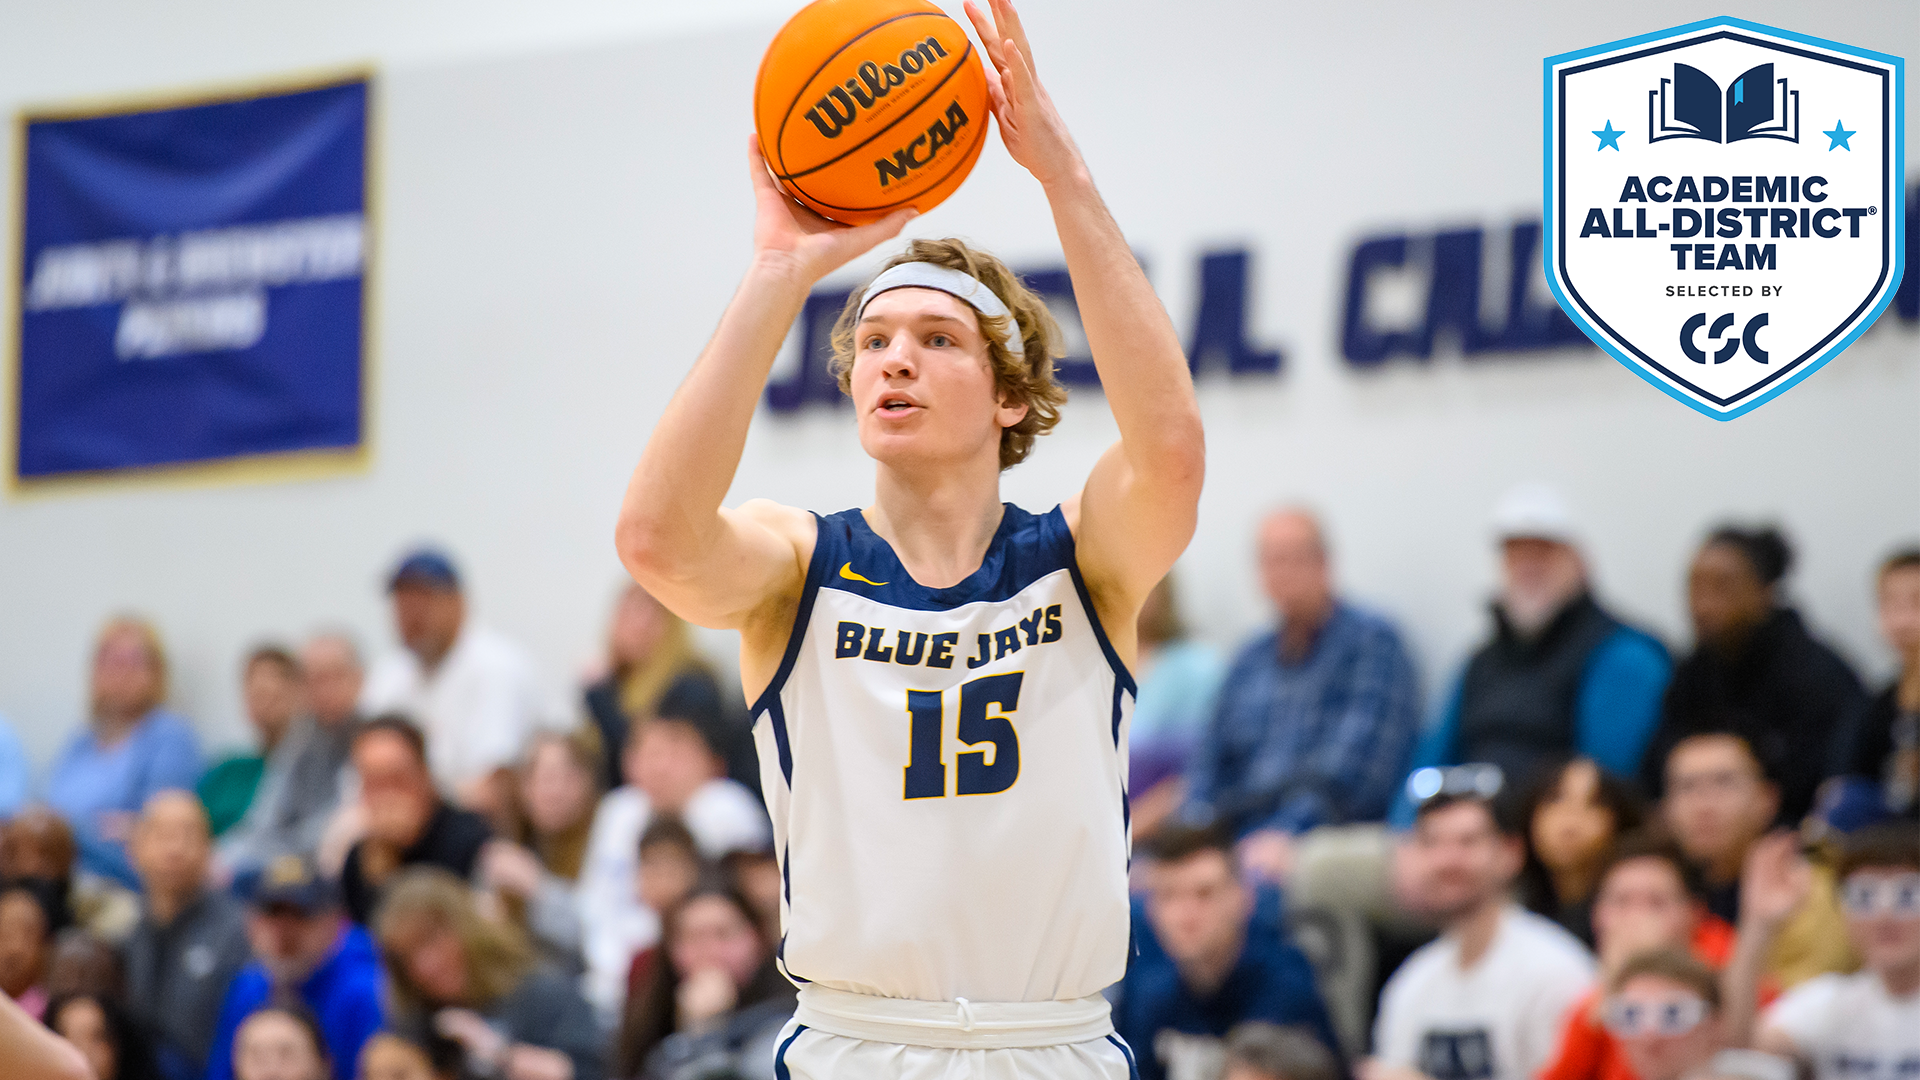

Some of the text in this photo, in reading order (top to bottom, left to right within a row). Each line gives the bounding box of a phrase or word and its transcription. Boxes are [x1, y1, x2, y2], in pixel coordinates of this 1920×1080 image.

[803, 36, 949, 139] Wilson
[874, 99, 969, 187] NCAA
[835, 604, 1063, 669] BLUE JAYS
[903, 670, 1025, 800] 15
